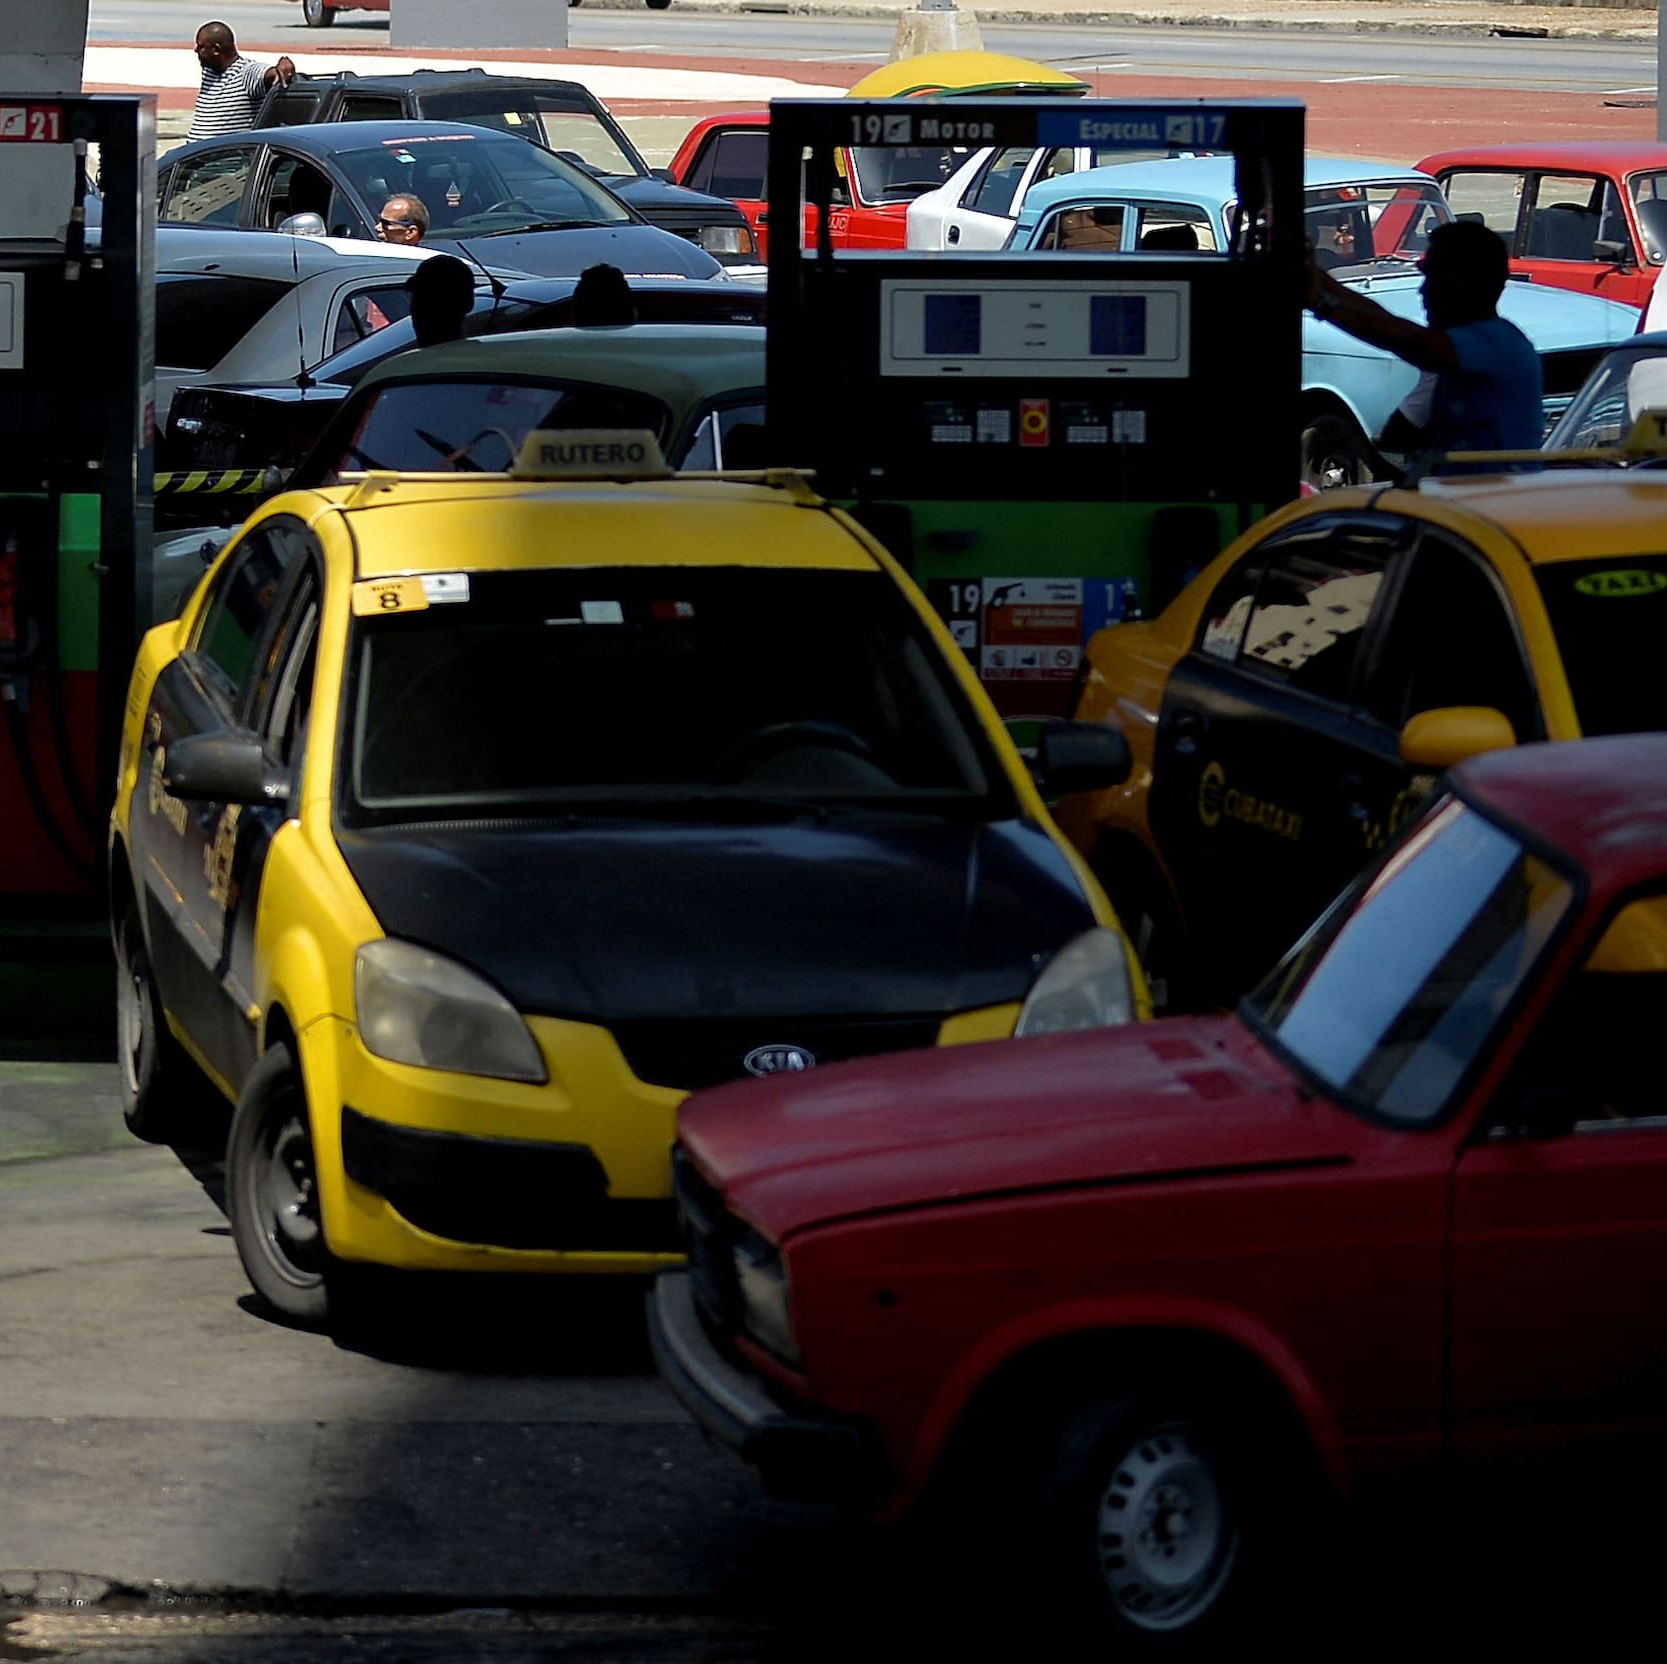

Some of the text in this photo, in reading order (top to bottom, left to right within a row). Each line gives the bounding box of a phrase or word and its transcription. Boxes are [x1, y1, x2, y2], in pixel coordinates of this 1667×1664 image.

[30, 111, 60, 140] 21
[849, 114, 1226, 144] 19 MOTOR ESPECIAL 17
[540, 442, 646, 464] RUTERO
[1590, 574, 1657, 592] TAXI
[380, 592, 400, 609] 8
[948, 583, 981, 614] 19
[758, 1051, 805, 1072] KIA
